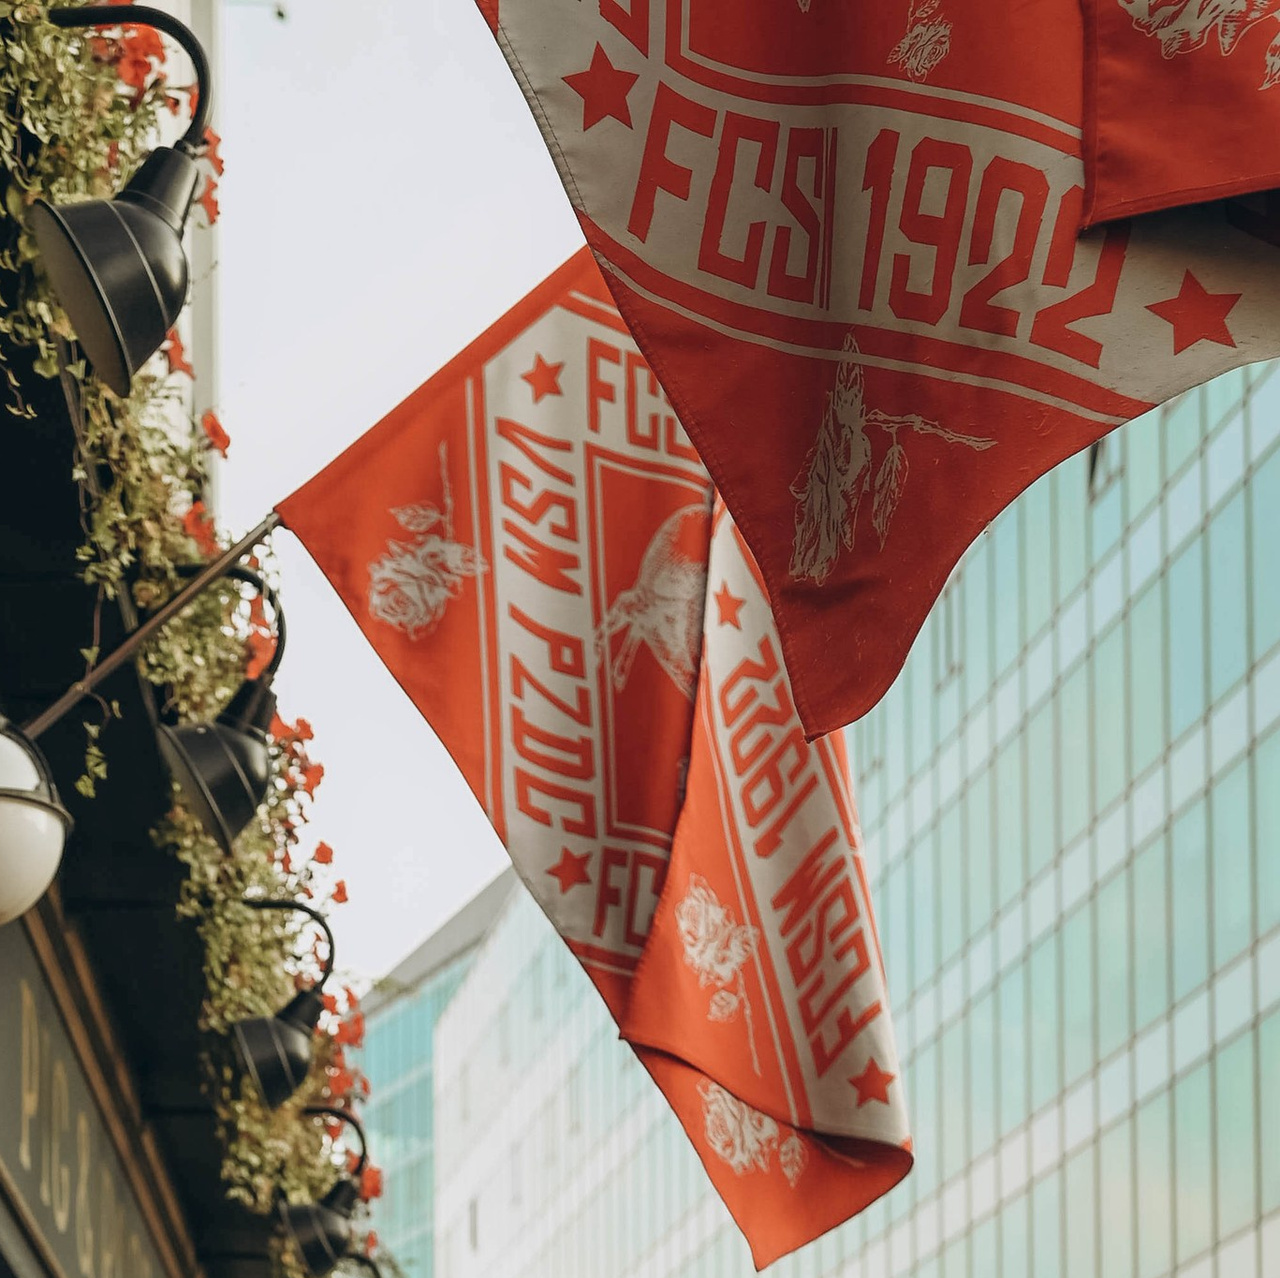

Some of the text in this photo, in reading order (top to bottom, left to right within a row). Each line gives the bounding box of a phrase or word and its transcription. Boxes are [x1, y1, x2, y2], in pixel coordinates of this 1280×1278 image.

[858, 128, 1131, 369] 1922
[495, 416, 599, 840] VSM PZDC
[720, 634, 883, 1079] FCSM 1922
